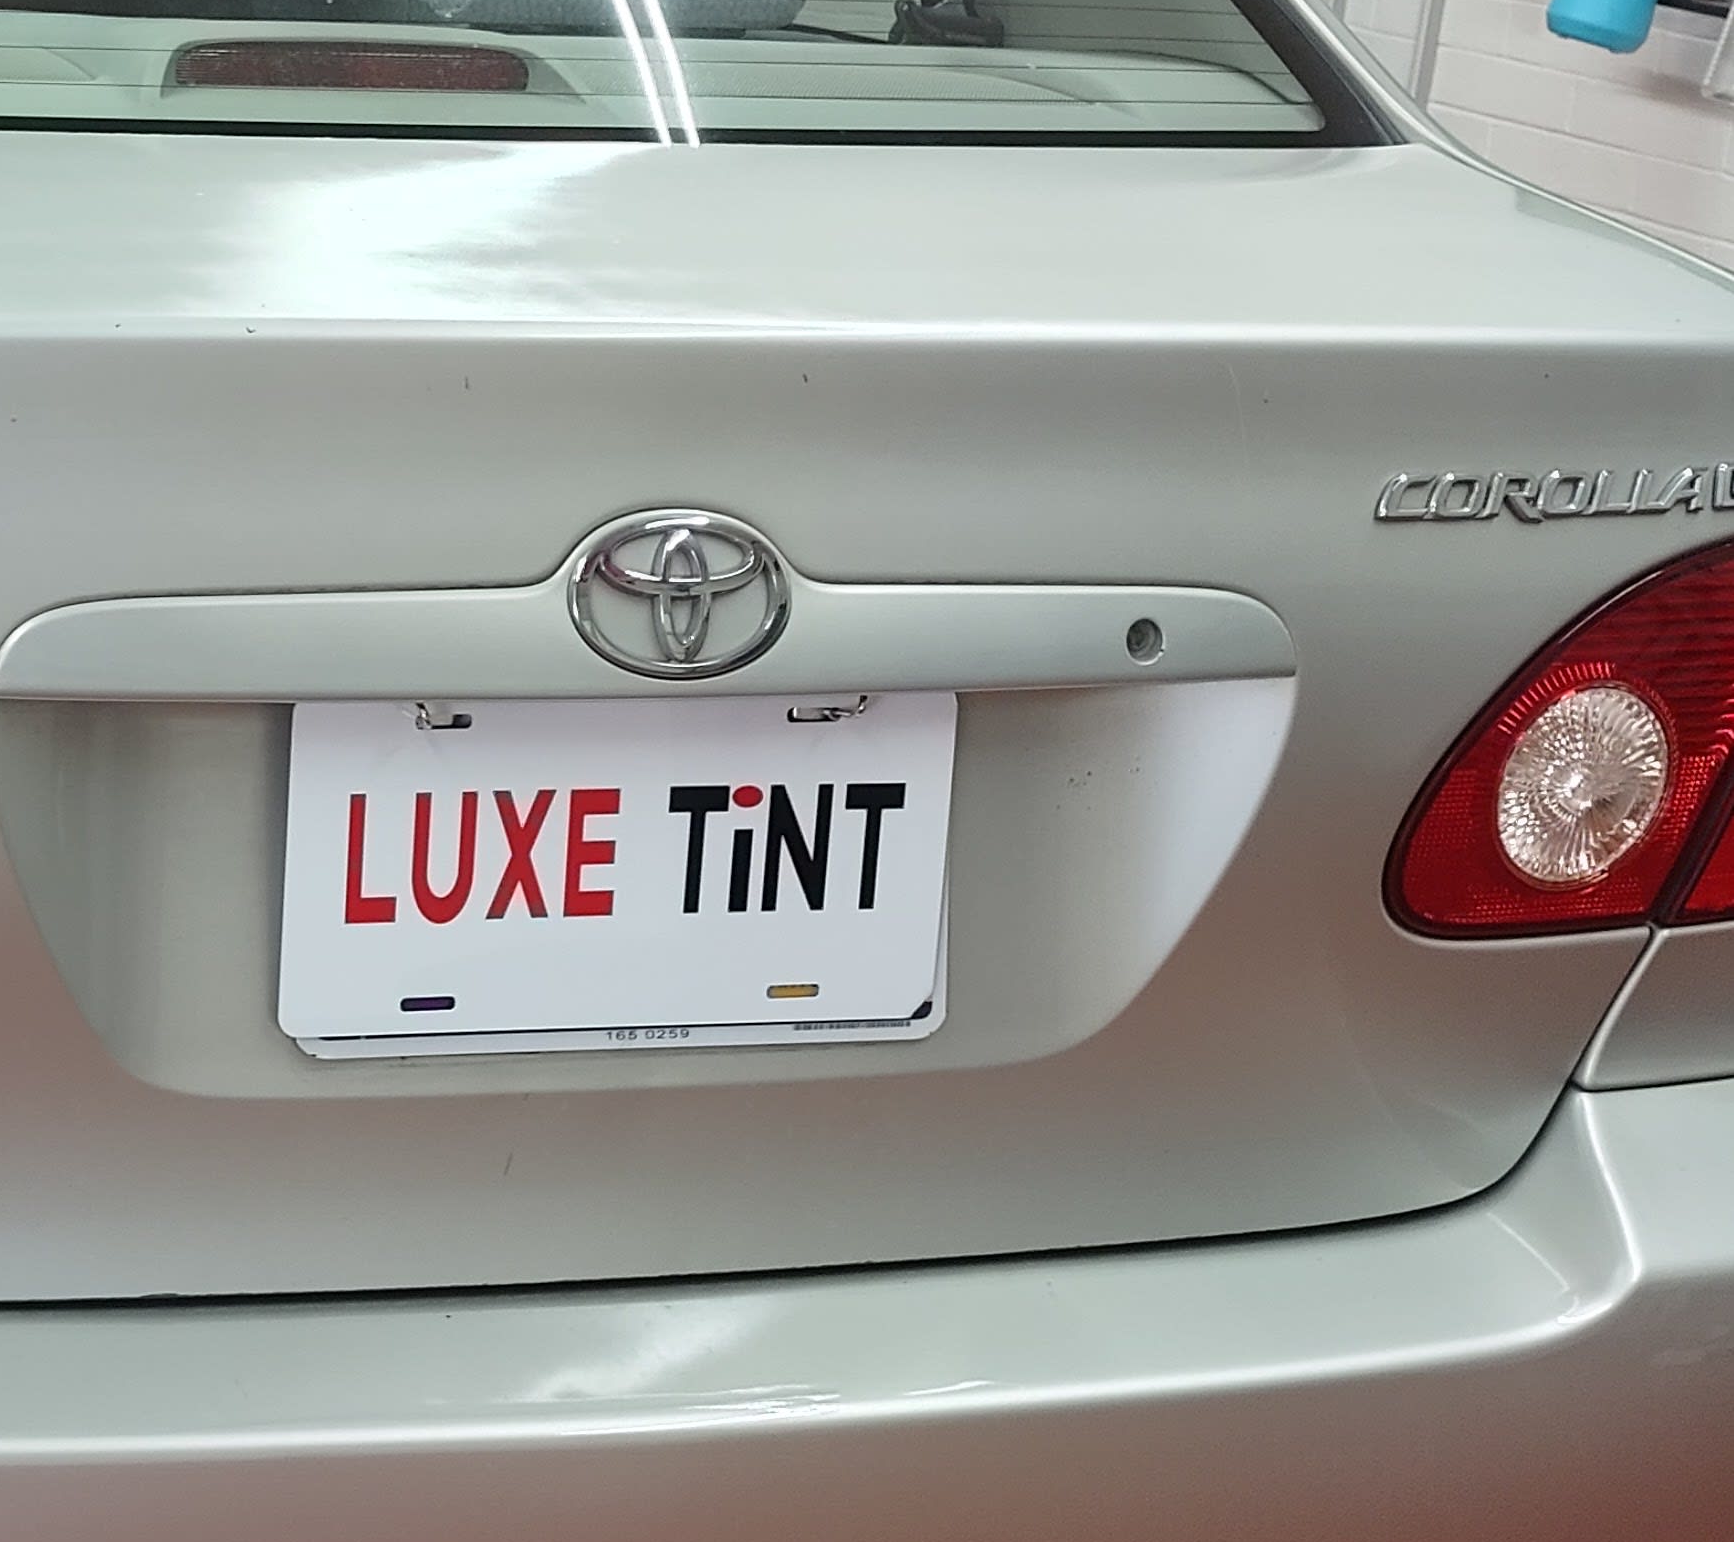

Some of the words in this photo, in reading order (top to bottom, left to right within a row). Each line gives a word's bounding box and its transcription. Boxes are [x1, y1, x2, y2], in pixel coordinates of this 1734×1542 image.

[1374, 467, 1707, 523] COROLLA
[344, 788, 621, 924] LUXE
[668, 783, 906, 913] TiNT
[606, 1030, 637, 1041] 165
[645, 1028, 690, 1039] 0259
